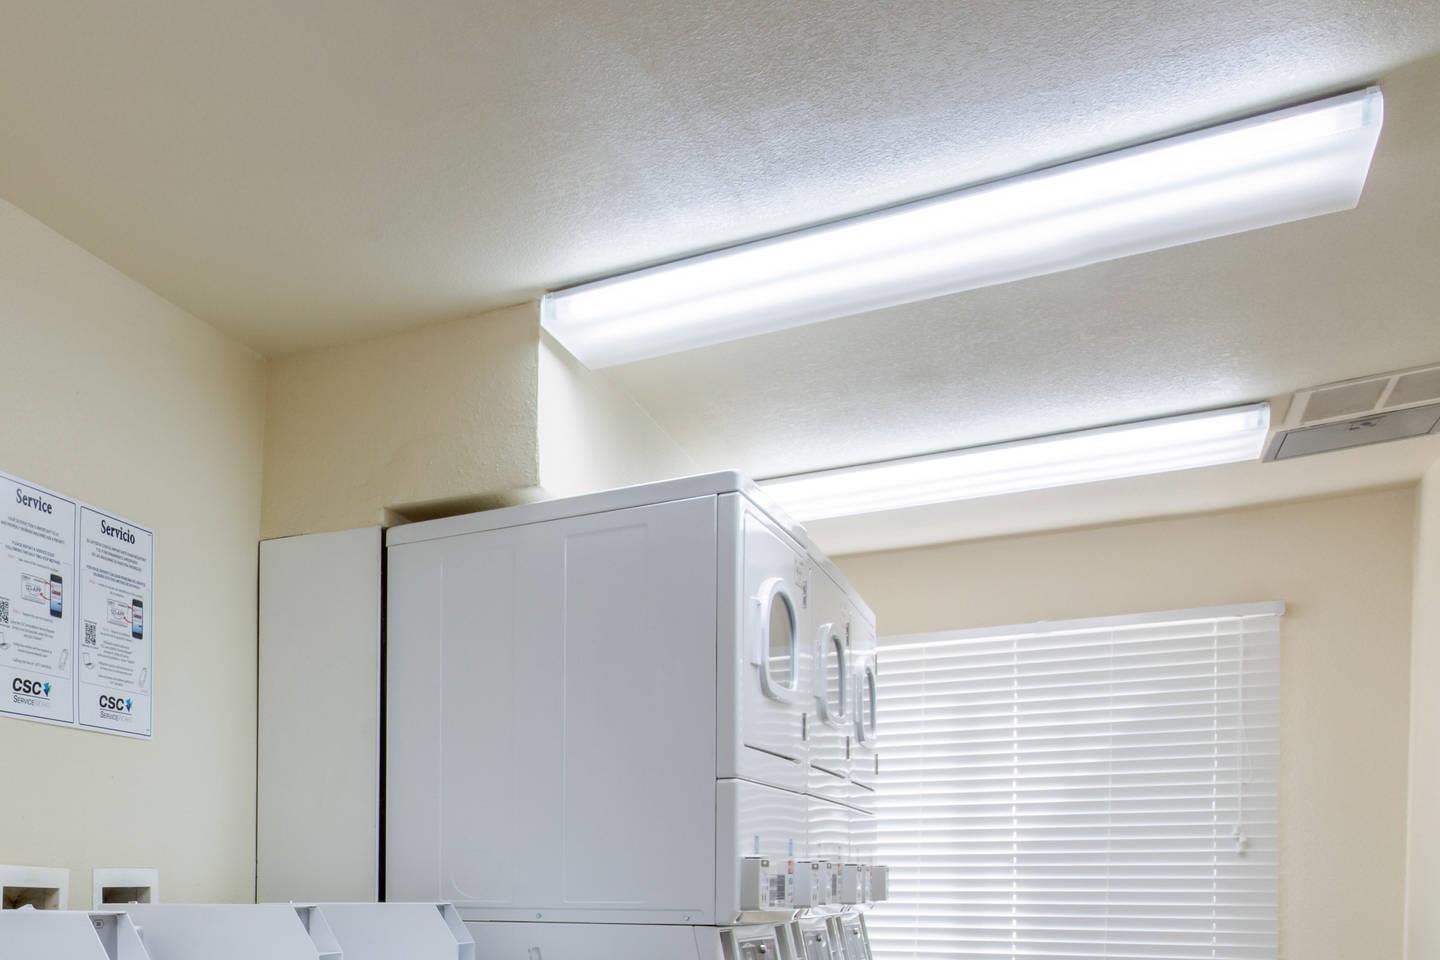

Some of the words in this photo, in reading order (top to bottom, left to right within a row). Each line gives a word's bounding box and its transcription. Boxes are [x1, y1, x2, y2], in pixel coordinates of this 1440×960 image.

[16, 489, 52, 514] Service
[101, 520, 135, 544] Servicio
[13, 678, 41, 695] CSC
[99, 695, 124, 711] CSC
